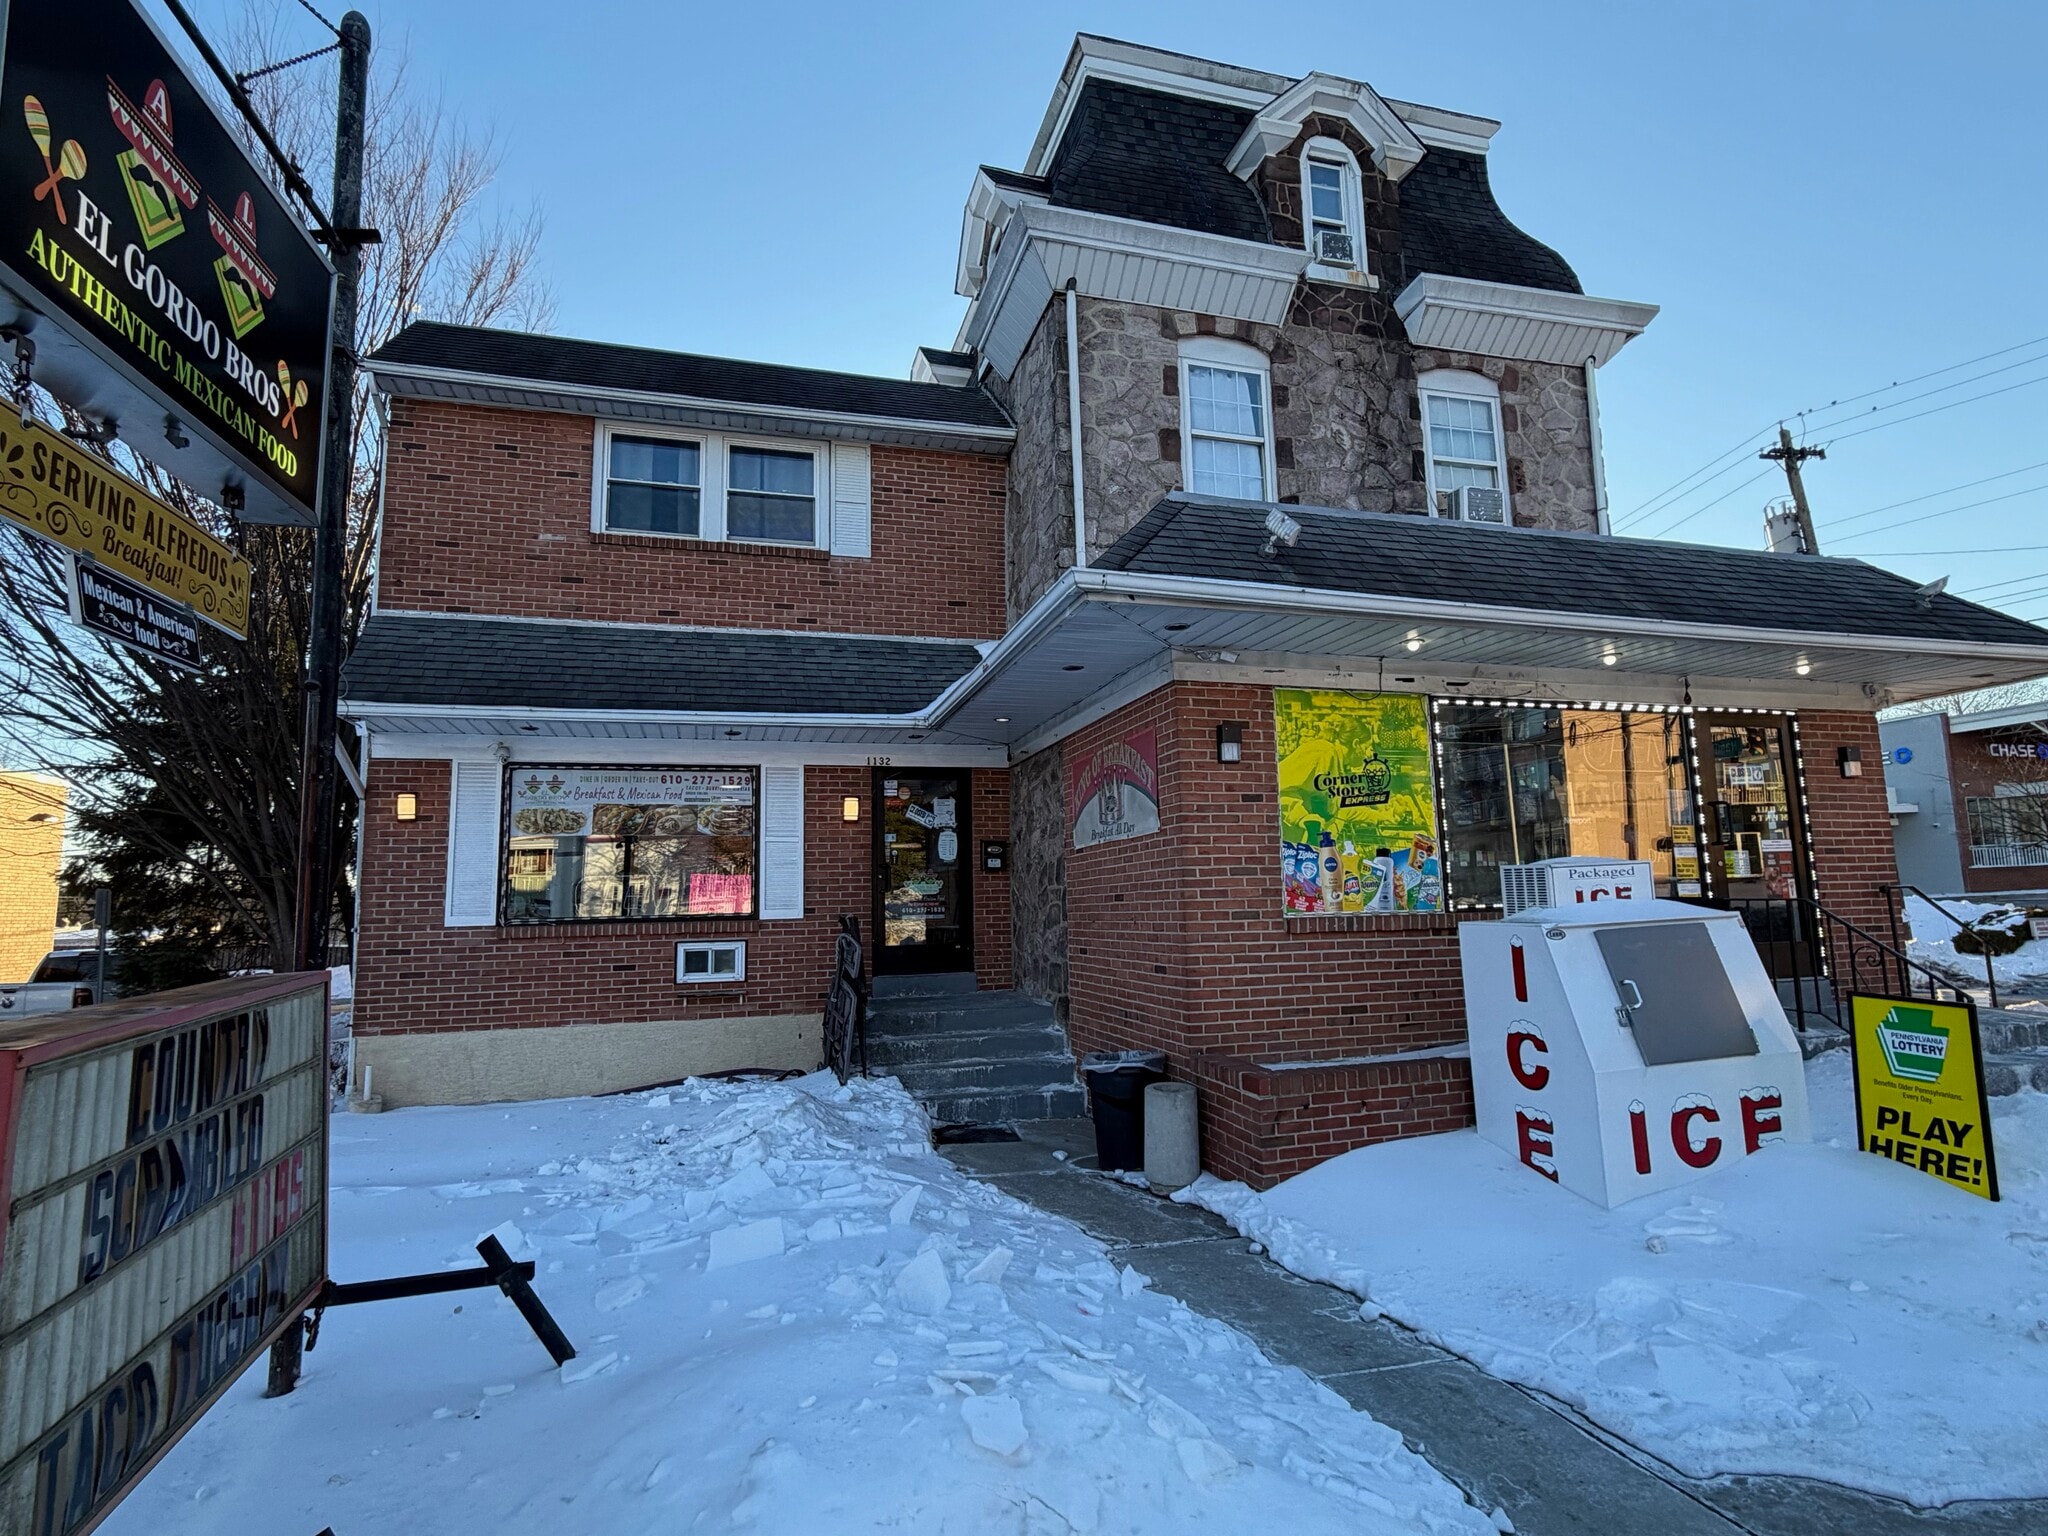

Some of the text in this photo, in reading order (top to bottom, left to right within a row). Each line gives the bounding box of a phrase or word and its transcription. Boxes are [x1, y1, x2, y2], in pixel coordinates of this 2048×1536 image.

[153, 87, 168, 125] A
[75, 190, 281, 418] EL GORDO BROS
[26, 227, 298, 478] AUTHENTIC MEXICAN FOOD
[31, 441, 228, 587] SERVING ALFREDOS
[102, 525, 184, 590] Breakfast!
[82, 572, 196, 643] Mexican & American
[133, 622, 160, 649] food
[866, 756, 891, 766] 1132
[1989, 743, 2037, 758] CHASE
[1091, 751, 1102, 776] OF
[1103, 742, 1155, 790] BREAKFAST
[574, 786, 615, 800] Breakfast
[618, 787, 626, 800] &
[627, 787, 661, 800] Mexican
[664, 787, 684, 800] Food
[661, 775, 751, 785] 610-277-1529
[1314, 771, 1366, 791] Corner
[1328, 785, 1365, 799] Store
[1345, 794, 1387, 805] EXPRESS
[1296, 850, 1318, 860] Ziploc
[1568, 867, 1636, 881] Packaged
[1575, 883, 1632, 903] ICE
[1890, 1031, 1944, 1045] PENNSYLVANIA
[1891, 1040, 1945, 1056] LOTTERY
[1506, 934, 1559, 1184] ICE
[130, 1010, 269, 1146] COUNTRY
[1873, 1078, 1964, 1101] Benefits Older Pennsylvanians.
[1902, 1092, 1920, 1103] Every
[1627, 1086, 1786, 1175] ICE
[1876, 1105, 1974, 1148] PLAY
[1869, 1135, 1983, 1186] HERE!
[84, 1093, 264, 1284] SCRAMBLED
[38, 1361, 159, 1536] TACO
